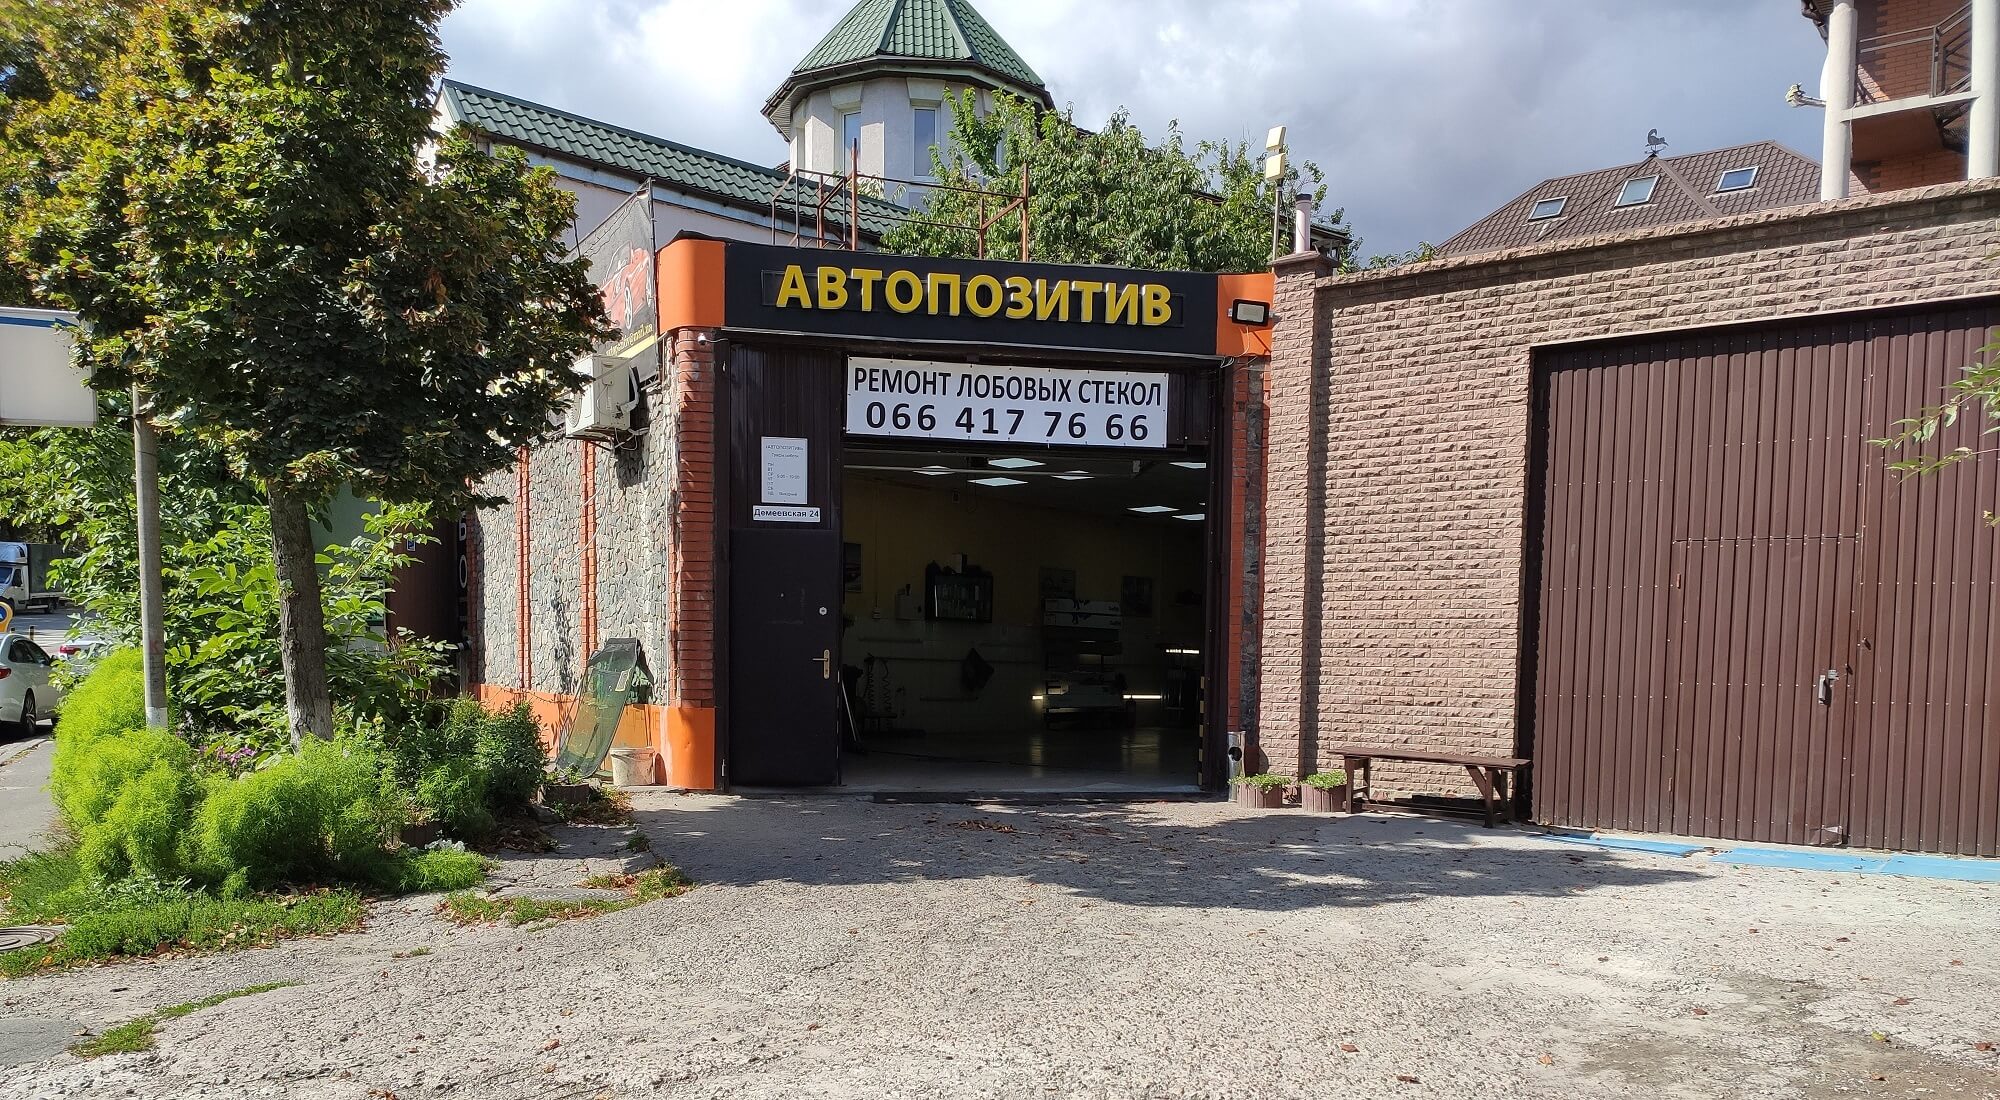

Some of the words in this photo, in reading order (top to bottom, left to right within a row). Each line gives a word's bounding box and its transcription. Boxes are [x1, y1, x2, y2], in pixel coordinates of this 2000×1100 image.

[776, 264, 1172, 326] АВТОПОЗИТИВ
[854, 367, 951, 396] РЕМОНТ
[957, 373, 1072, 402] ЛОБОВЫХ
[1078, 379, 1161, 407] СТЕКОЛ
[866, 401, 936, 431] 066
[955, 407, 1025, 435] 417
[1044, 411, 1087, 438] 76
[1105, 413, 1149, 441] 66
[809, 510, 819, 518] 24
